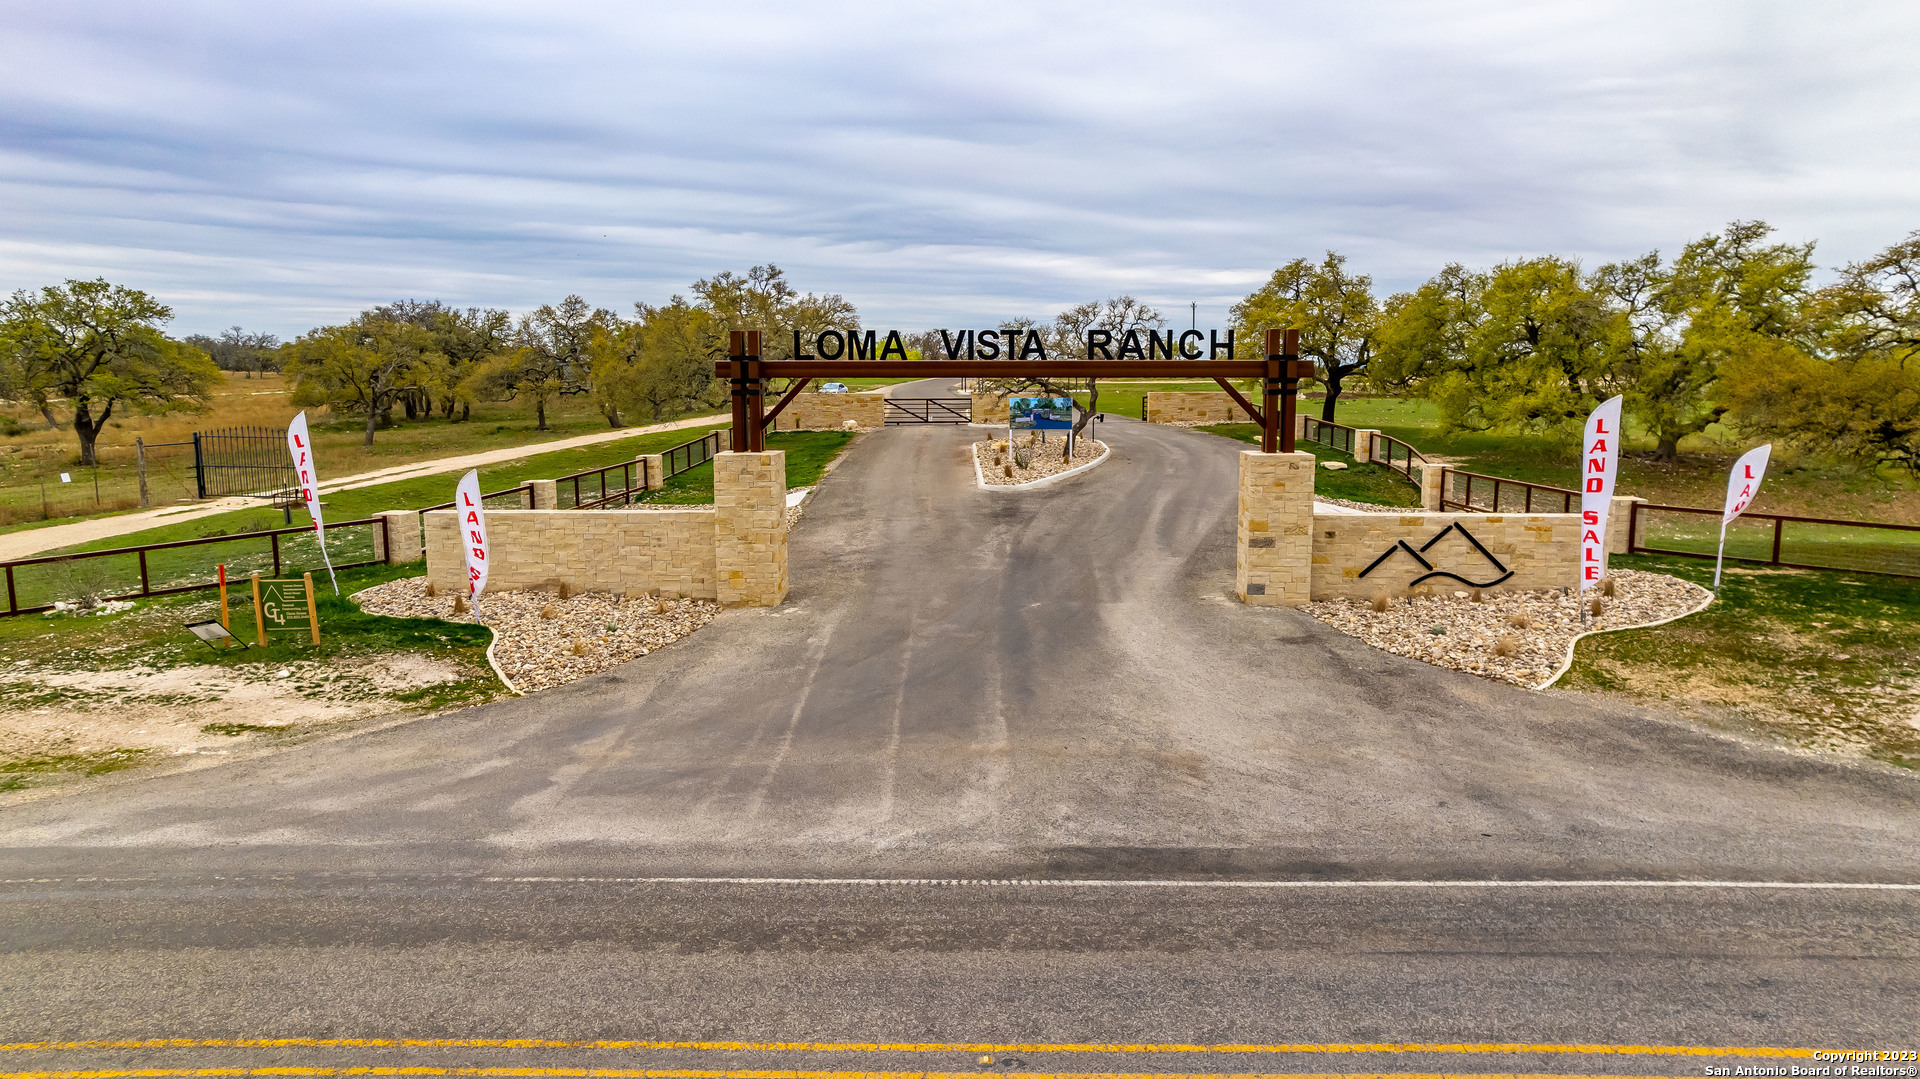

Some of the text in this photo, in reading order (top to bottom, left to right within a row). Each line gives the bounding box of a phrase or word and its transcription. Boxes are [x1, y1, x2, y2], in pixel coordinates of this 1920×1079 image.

[794, 329, 1235, 361] LOMA VISTA RANCH
[463, 492, 485, 561] LAND
[1582, 418, 1609, 581] LAND SALE
